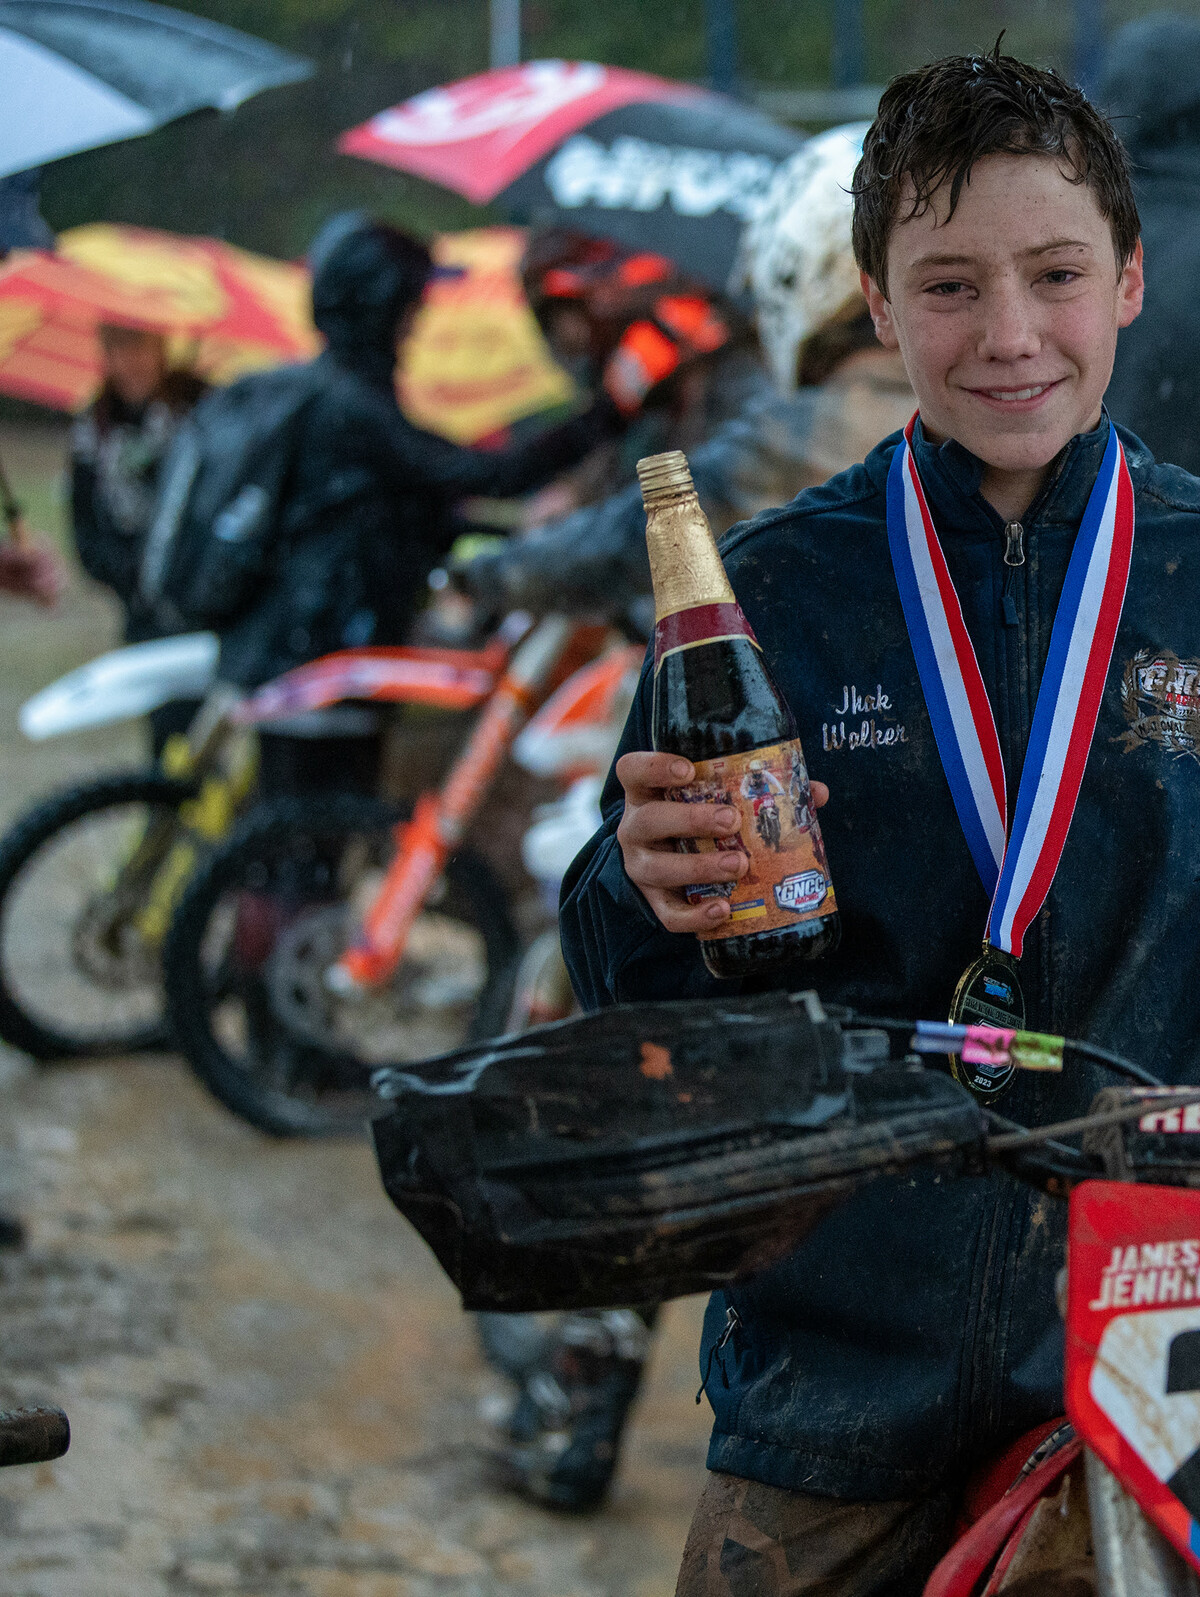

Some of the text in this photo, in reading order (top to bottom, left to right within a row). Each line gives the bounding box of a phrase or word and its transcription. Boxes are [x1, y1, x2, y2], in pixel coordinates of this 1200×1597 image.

[822, 719, 909, 752] Walker
[782, 877, 823, 901] GNCC
[973, 1075, 992, 1088] 2023
[1102, 1239, 1200, 1274] JAMES
